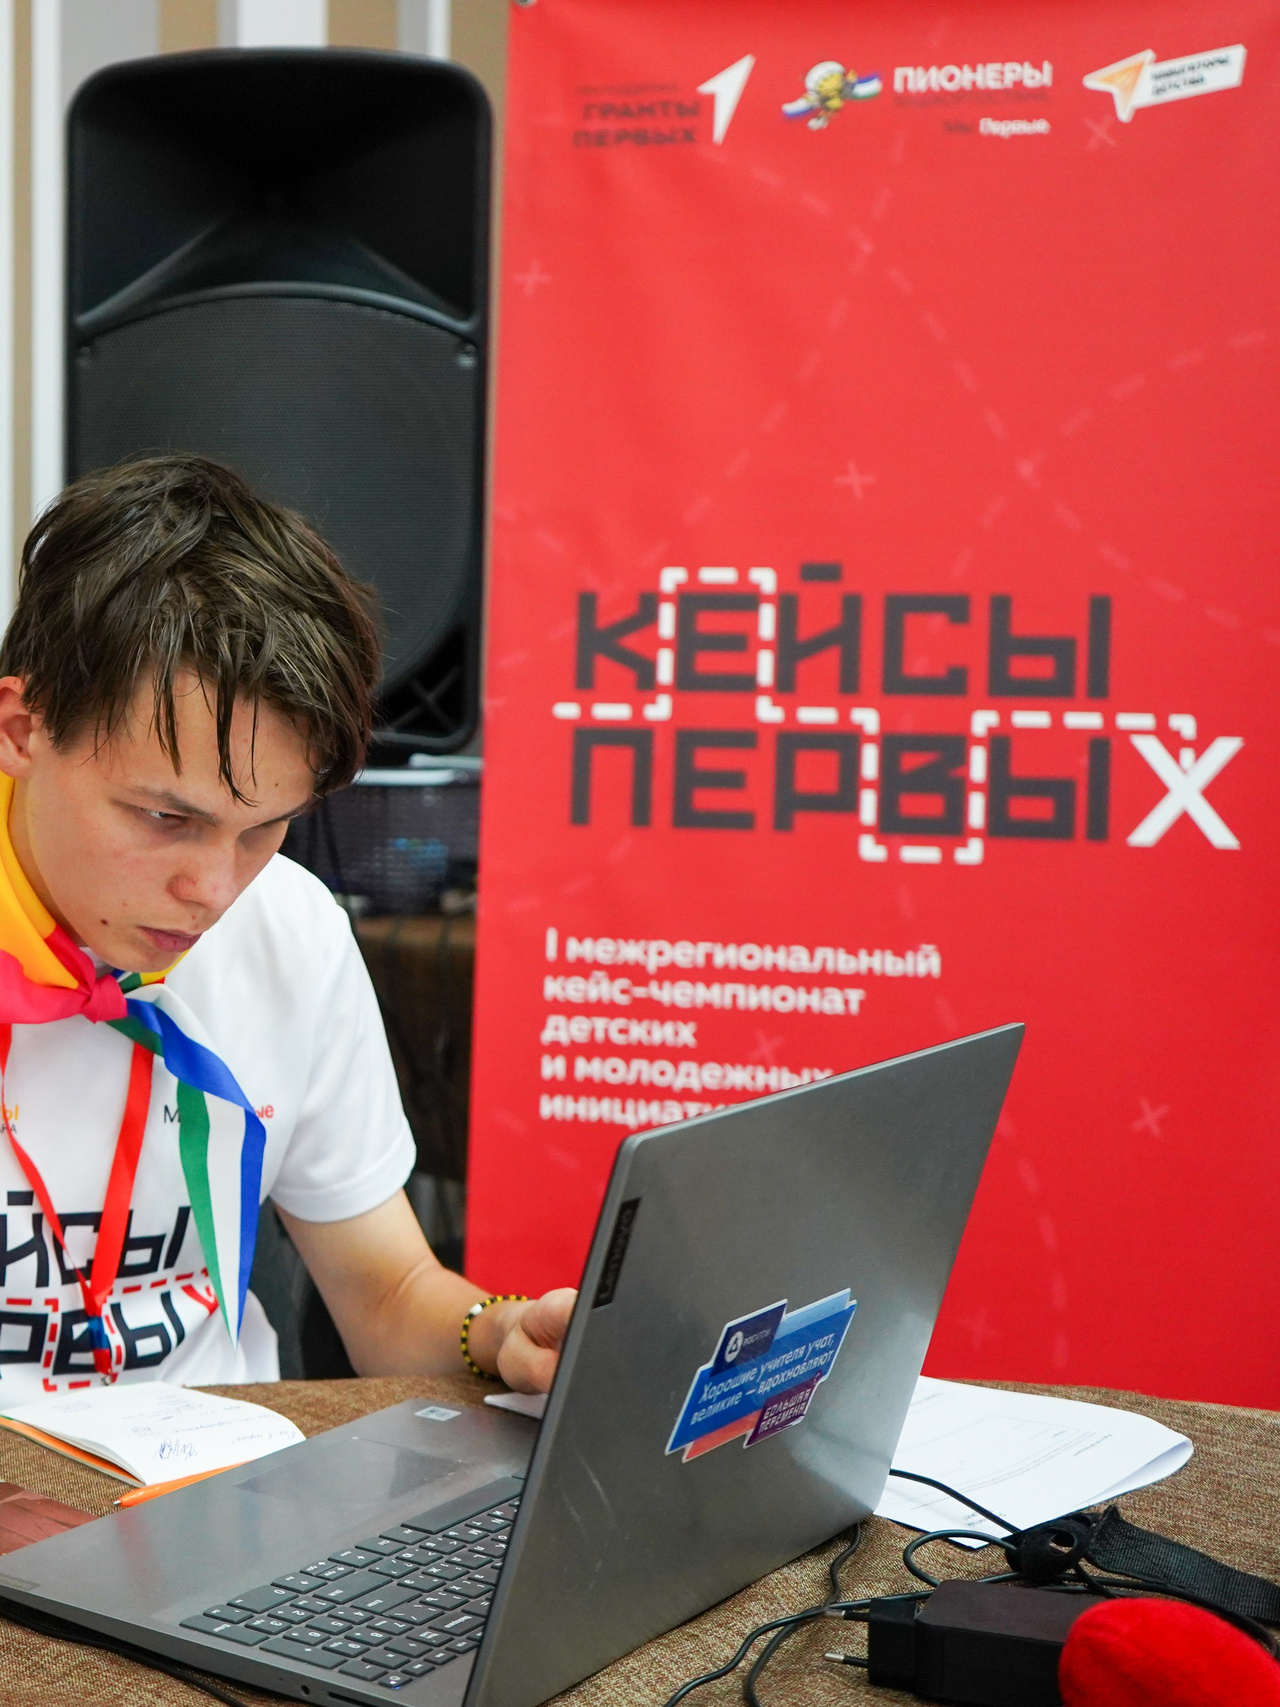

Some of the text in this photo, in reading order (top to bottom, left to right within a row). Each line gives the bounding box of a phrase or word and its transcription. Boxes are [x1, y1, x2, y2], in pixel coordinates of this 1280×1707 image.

[893, 60, 1053, 93] ПИОНЕРЫ
[583, 101, 700, 120] ГРАНТЫ
[573, 127, 697, 146] ПЕРВЫХ
[575, 562, 1112, 698] КЕЙСЫ
[570, 727, 1244, 850] ПЕРВЫХ
[565, 935, 942, 978] межрегиональный
[543, 971, 866, 1015] кейс-чемпионат
[541, 1014, 697, 1048] детских
[541, 1055, 566, 1080] и
[690, 1394, 743, 1425] великие
[757, 1350, 835, 1395] вдохновляют
[698, 1367, 758, 1404] Хорошие
[757, 1345, 806, 1382] учителя
[758, 1402, 806, 1431] ПЕРЕМЕНА
